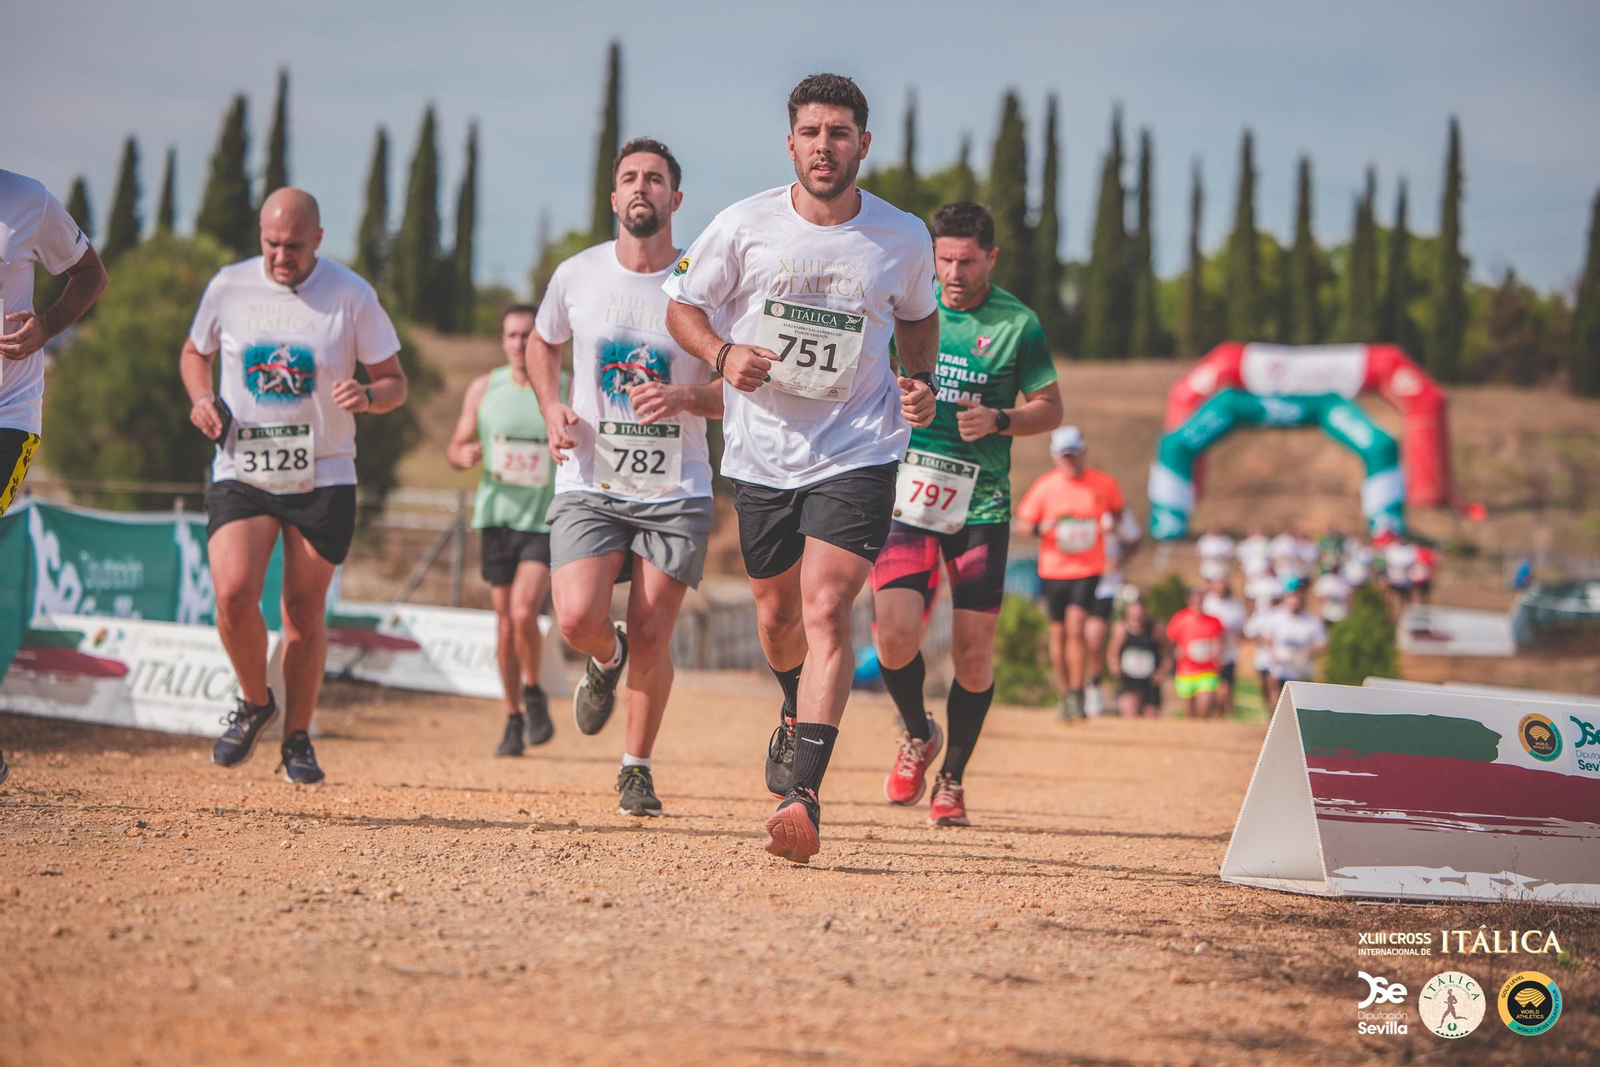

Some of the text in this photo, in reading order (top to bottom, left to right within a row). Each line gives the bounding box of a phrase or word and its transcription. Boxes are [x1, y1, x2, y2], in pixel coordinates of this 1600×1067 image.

[780, 259, 821, 273] XLIII
[790, 308, 838, 326] ITÁLICA
[778, 333, 837, 373] 751
[939, 353, 969, 367] TRAIL
[940, 377, 959, 388] LAS
[621, 425, 661, 436] ITÁLICA
[243, 448, 308, 473] 3128
[613, 448, 665, 474] 782
[909, 480, 958, 511] 797
